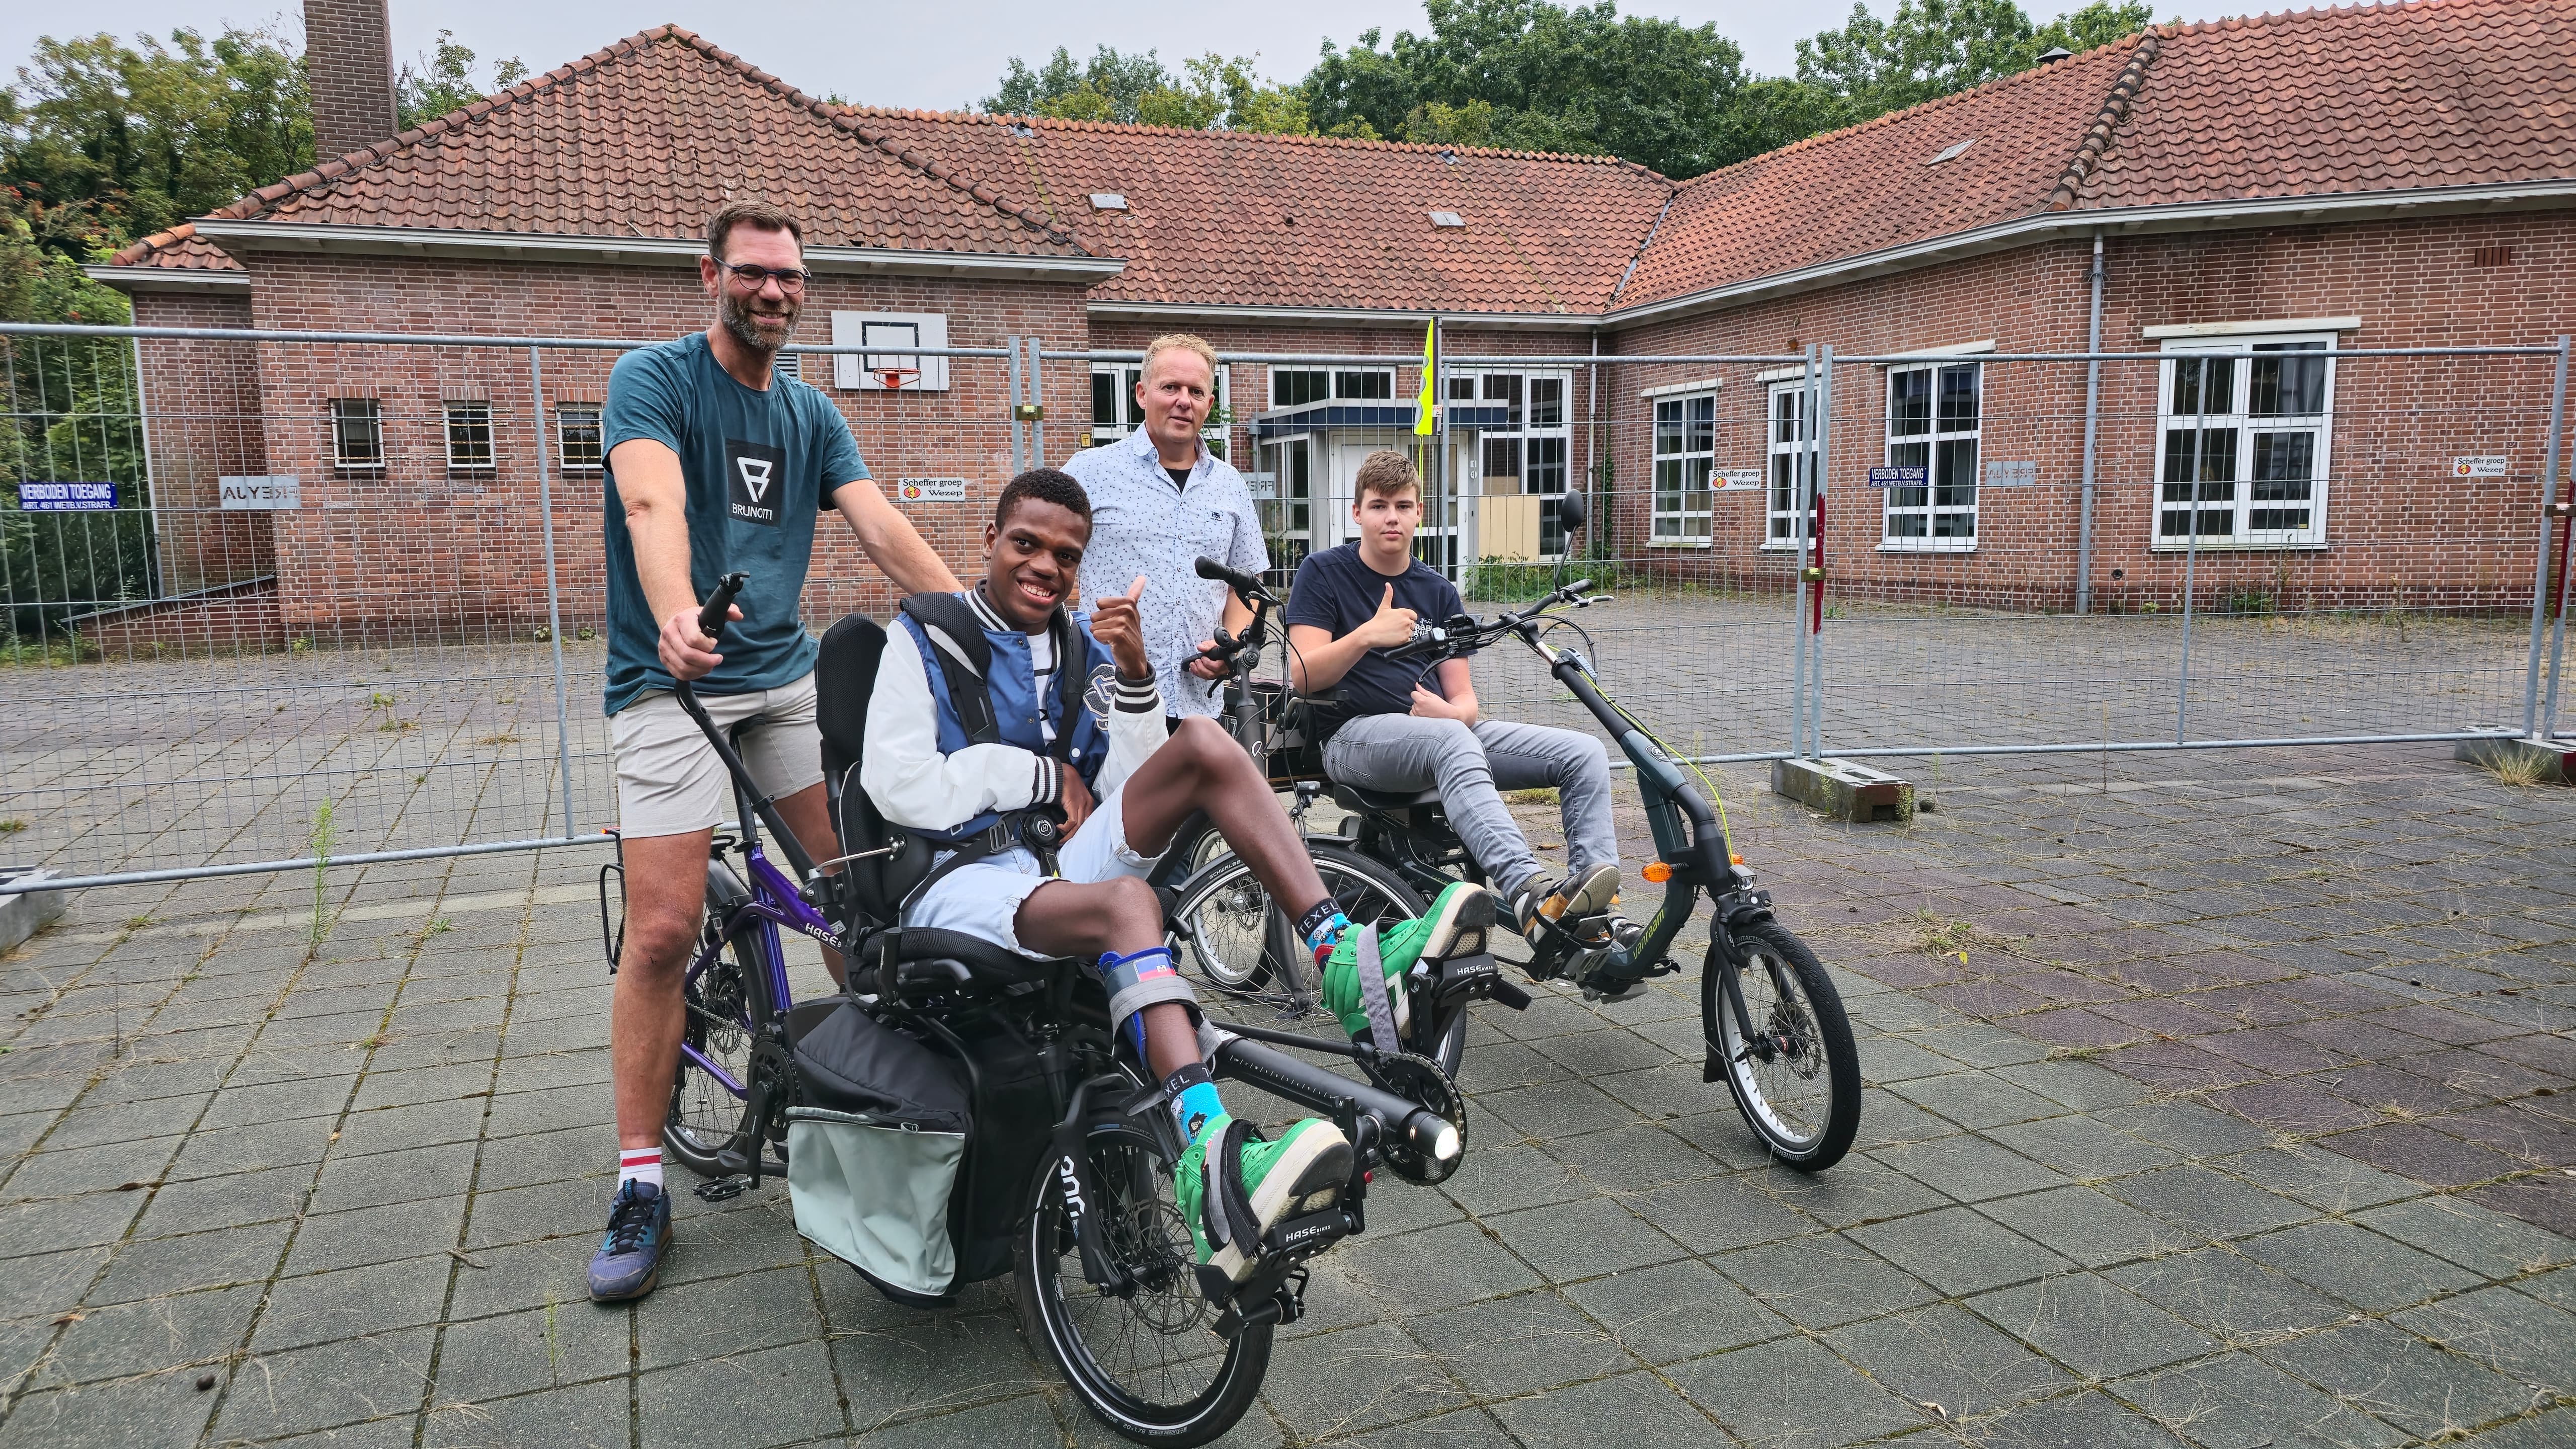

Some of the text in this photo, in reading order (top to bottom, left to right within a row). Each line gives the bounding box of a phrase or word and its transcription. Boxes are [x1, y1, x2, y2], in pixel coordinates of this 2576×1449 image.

[1872, 468, 1923, 479] VERBODEN TOEGANG
[20, 484, 111, 499] VERBODEN TOEGANG
[939, 479, 962, 488] groep
[23, 501, 112, 509] ART. 461 WETB.V.STRAFR.
[732, 503, 772, 520] BRUNOTTI
[1209, 859, 1241, 879] SCHWALBE
[1529, 874, 1543, 885] PUMA
[1299, 902, 1338, 934] TEXEL
[805, 922, 838, 946] HASE
[1457, 964, 1482, 975] HASE
[1285, 1225, 1331, 1242] HASE BIKES
[1092, 1402, 1118, 1424] 47-406
